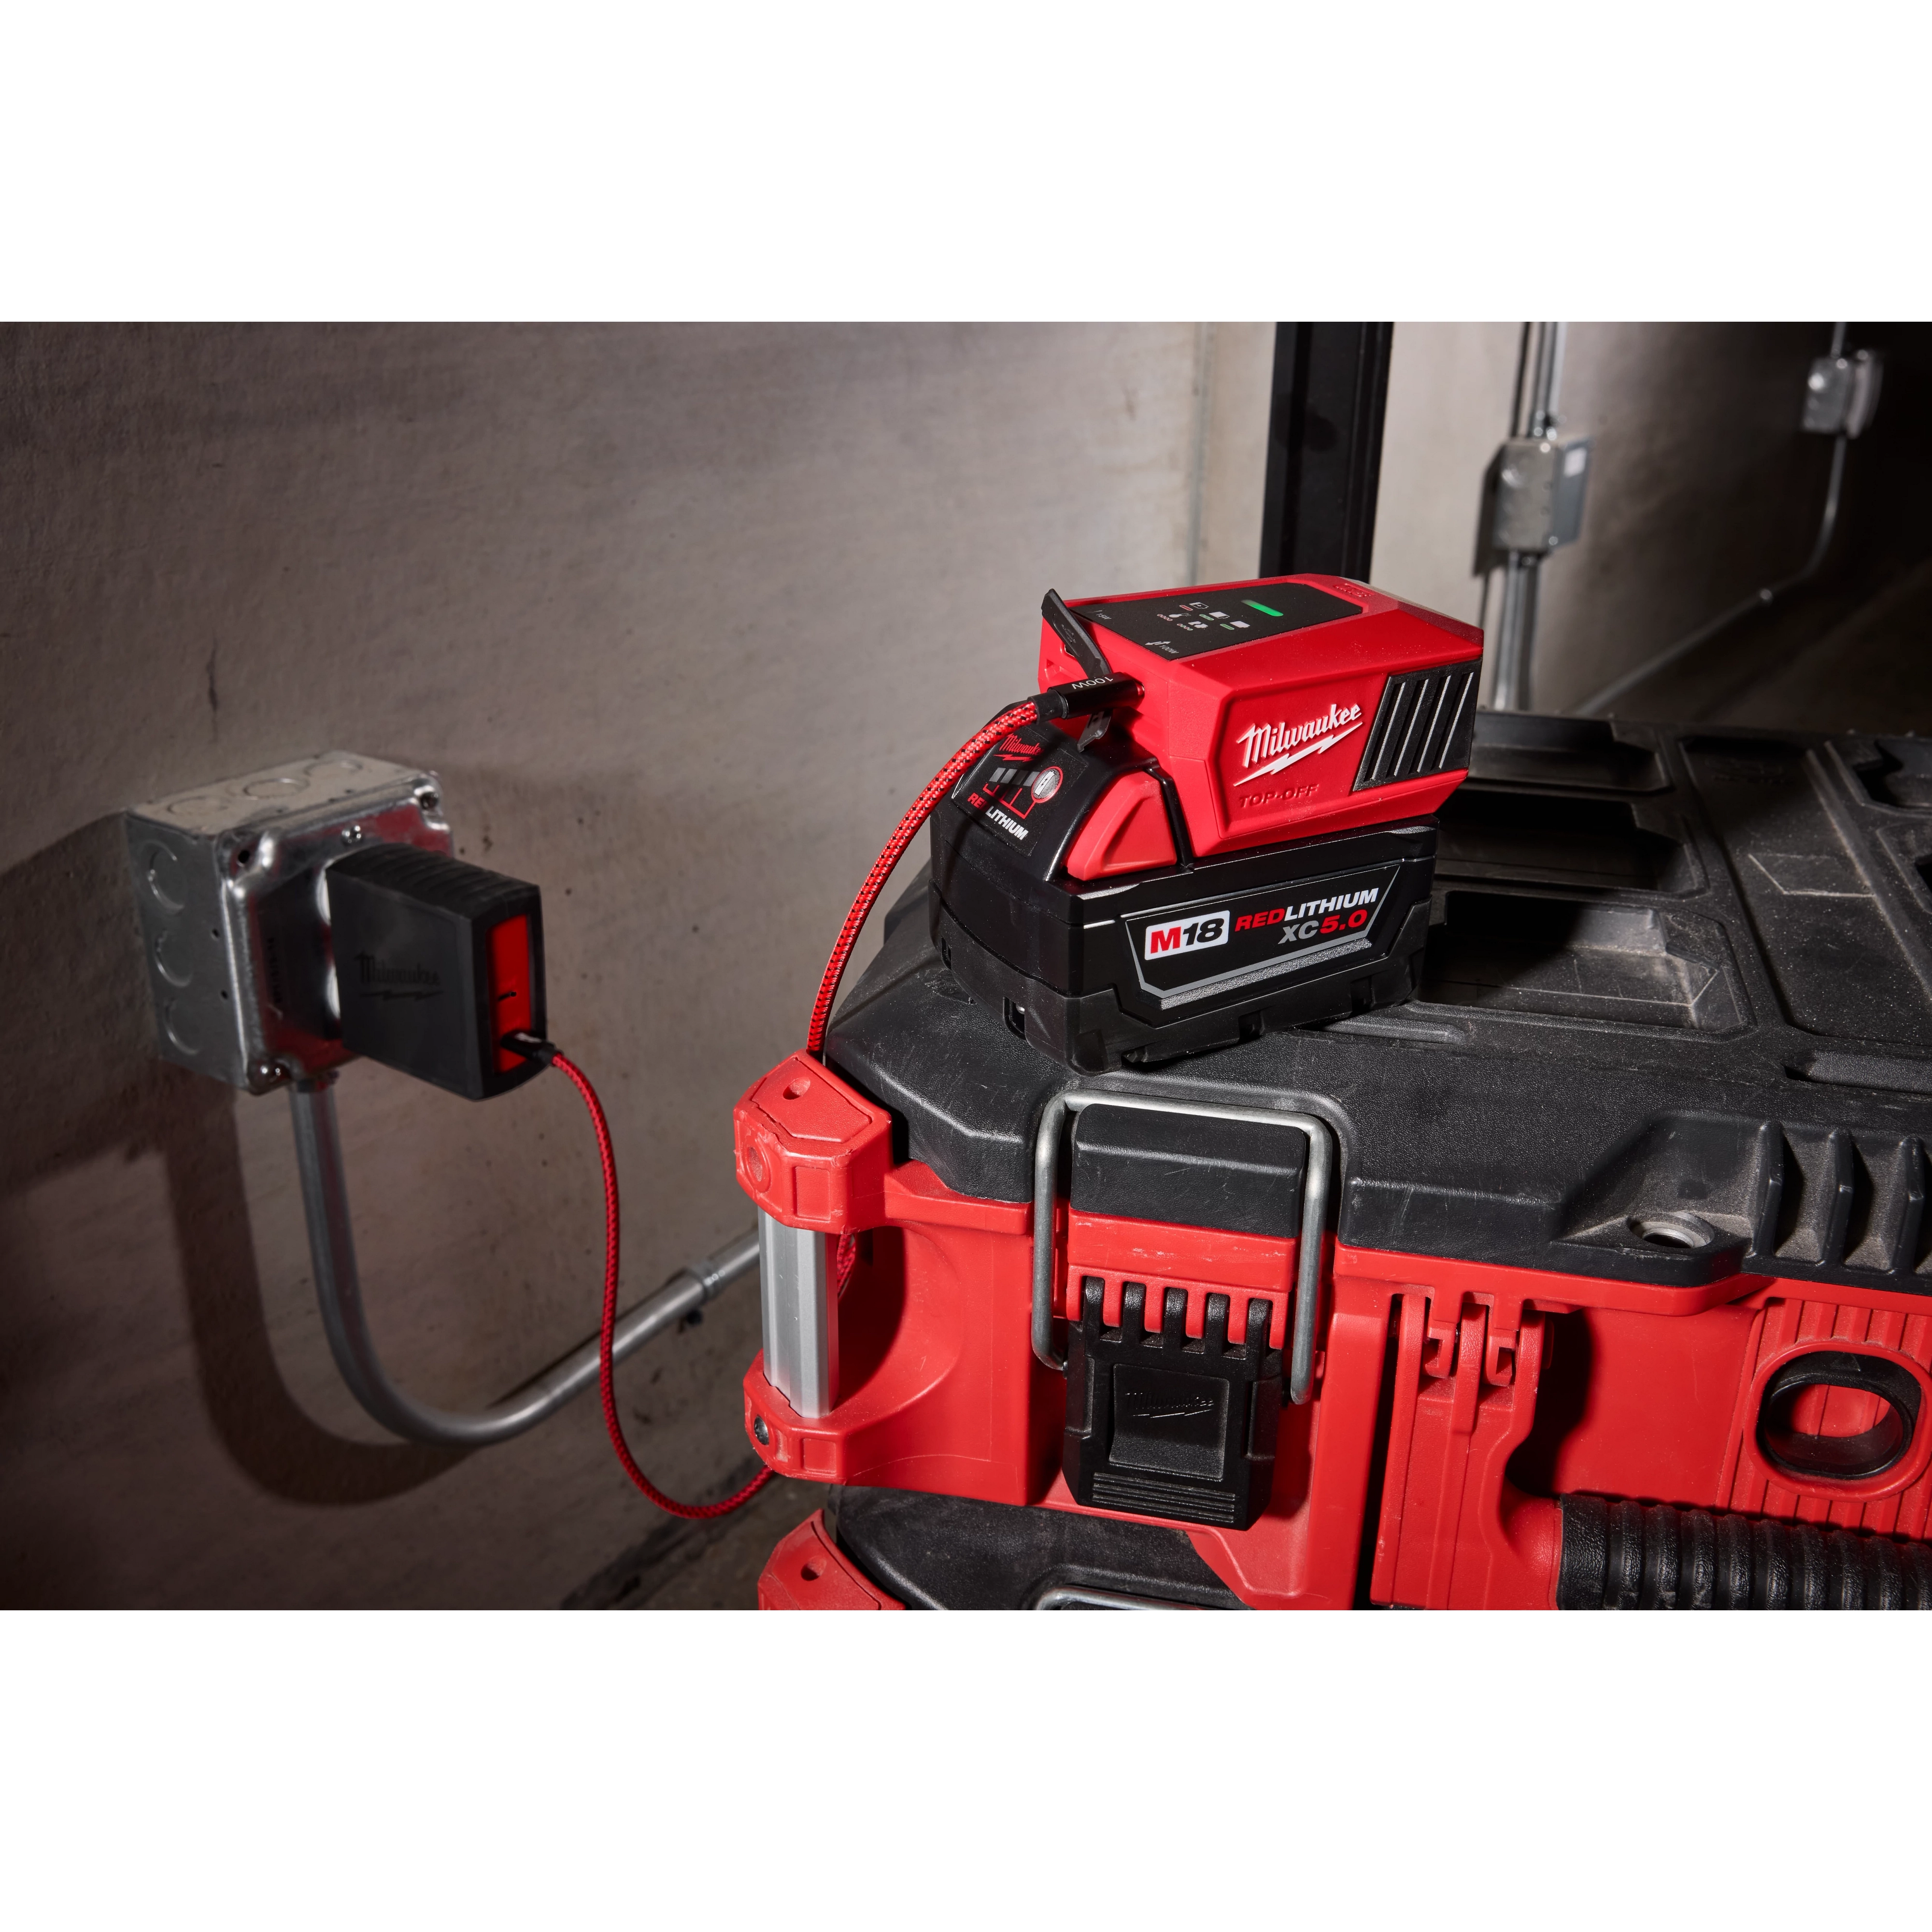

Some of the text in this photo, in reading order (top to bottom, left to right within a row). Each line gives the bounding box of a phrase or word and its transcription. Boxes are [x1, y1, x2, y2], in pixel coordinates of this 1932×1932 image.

[1160, 645, 1179, 653] 100W
[1071, 677, 1113, 689] 100W
[998, 733, 1044, 755] Milwauke
[1236, 703, 1362, 768] Milwaukee
[1239, 783, 1319, 809] TOP-OFF
[1235, 887, 1379, 932] REDLITHIUM
[1150, 918, 1225, 954] M18
[1278, 909, 1367, 944] XC5.0
